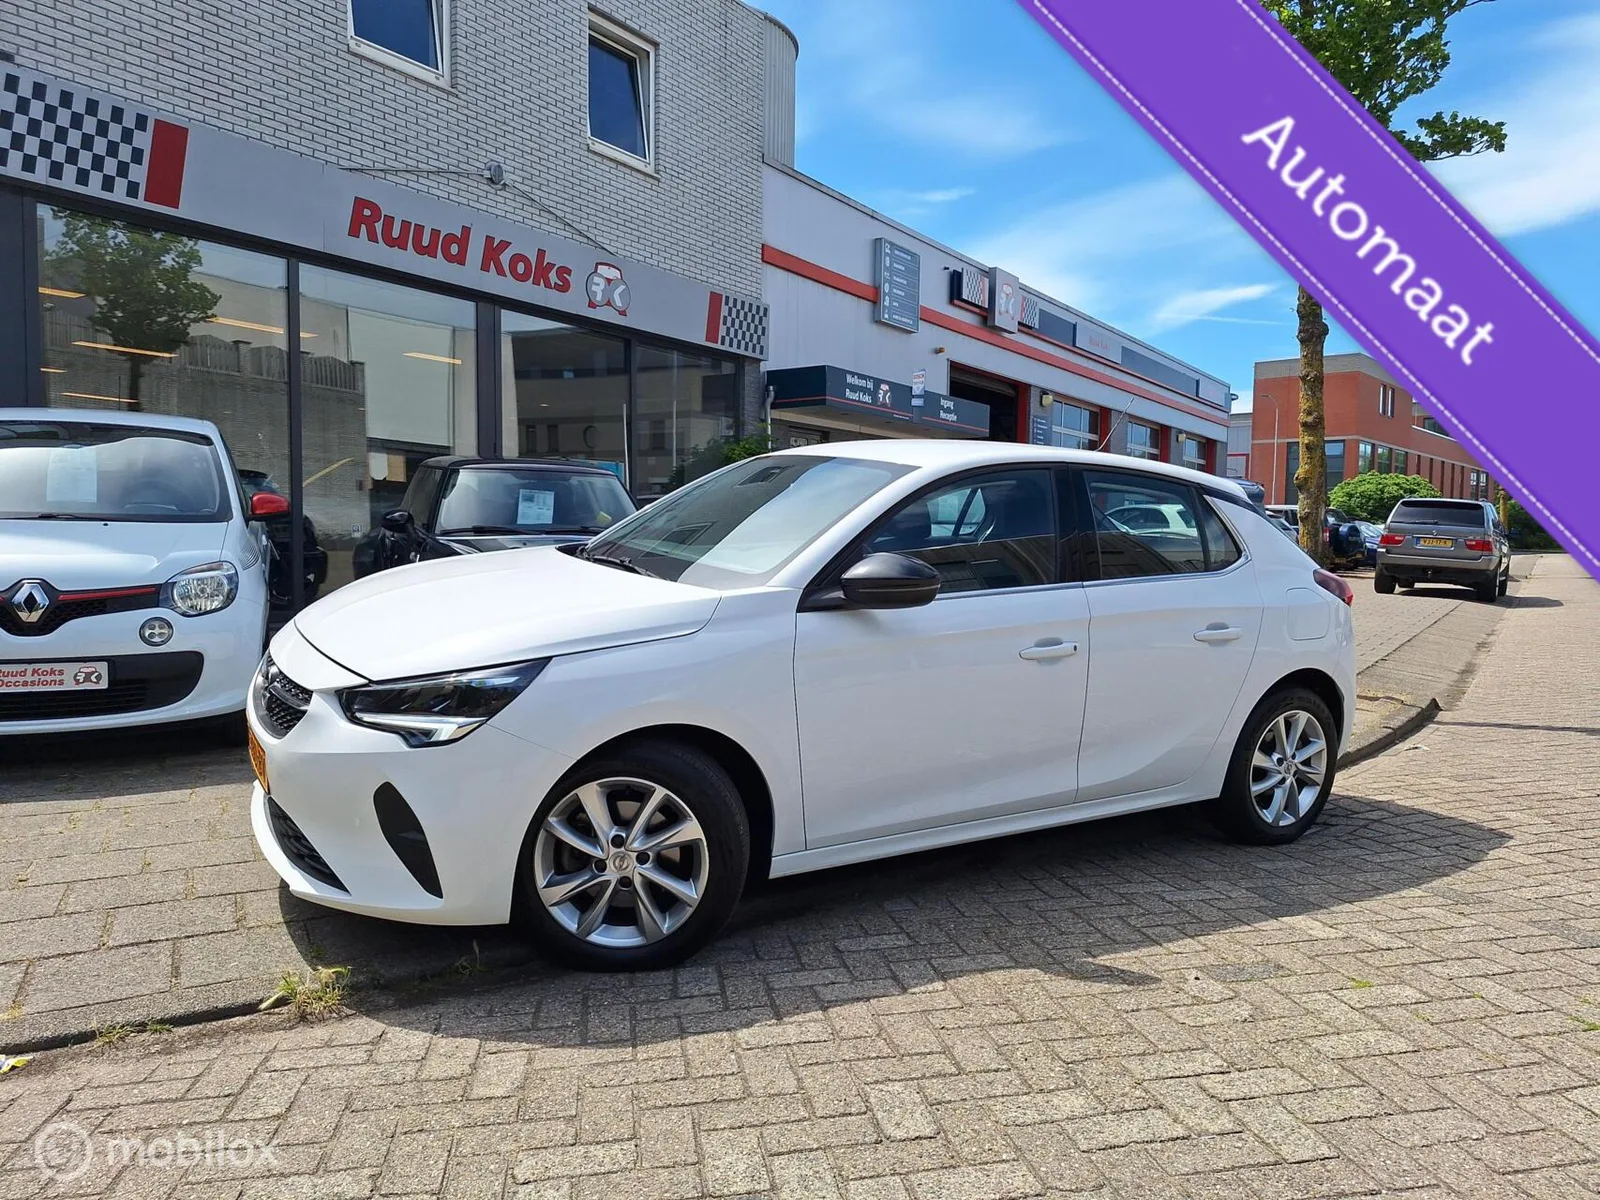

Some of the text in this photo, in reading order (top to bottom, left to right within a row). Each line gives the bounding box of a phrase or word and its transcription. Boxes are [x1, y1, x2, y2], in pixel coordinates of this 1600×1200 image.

[347, 196, 573, 294] Ruud Koks
[846, 373, 866, 387] Welkom
[845, 388, 872, 403] Ruud Koks
[940, 397, 954, 410] Ingang
[940, 410, 957, 422] Receptie
[0, 667, 65, 678] uud Koks
